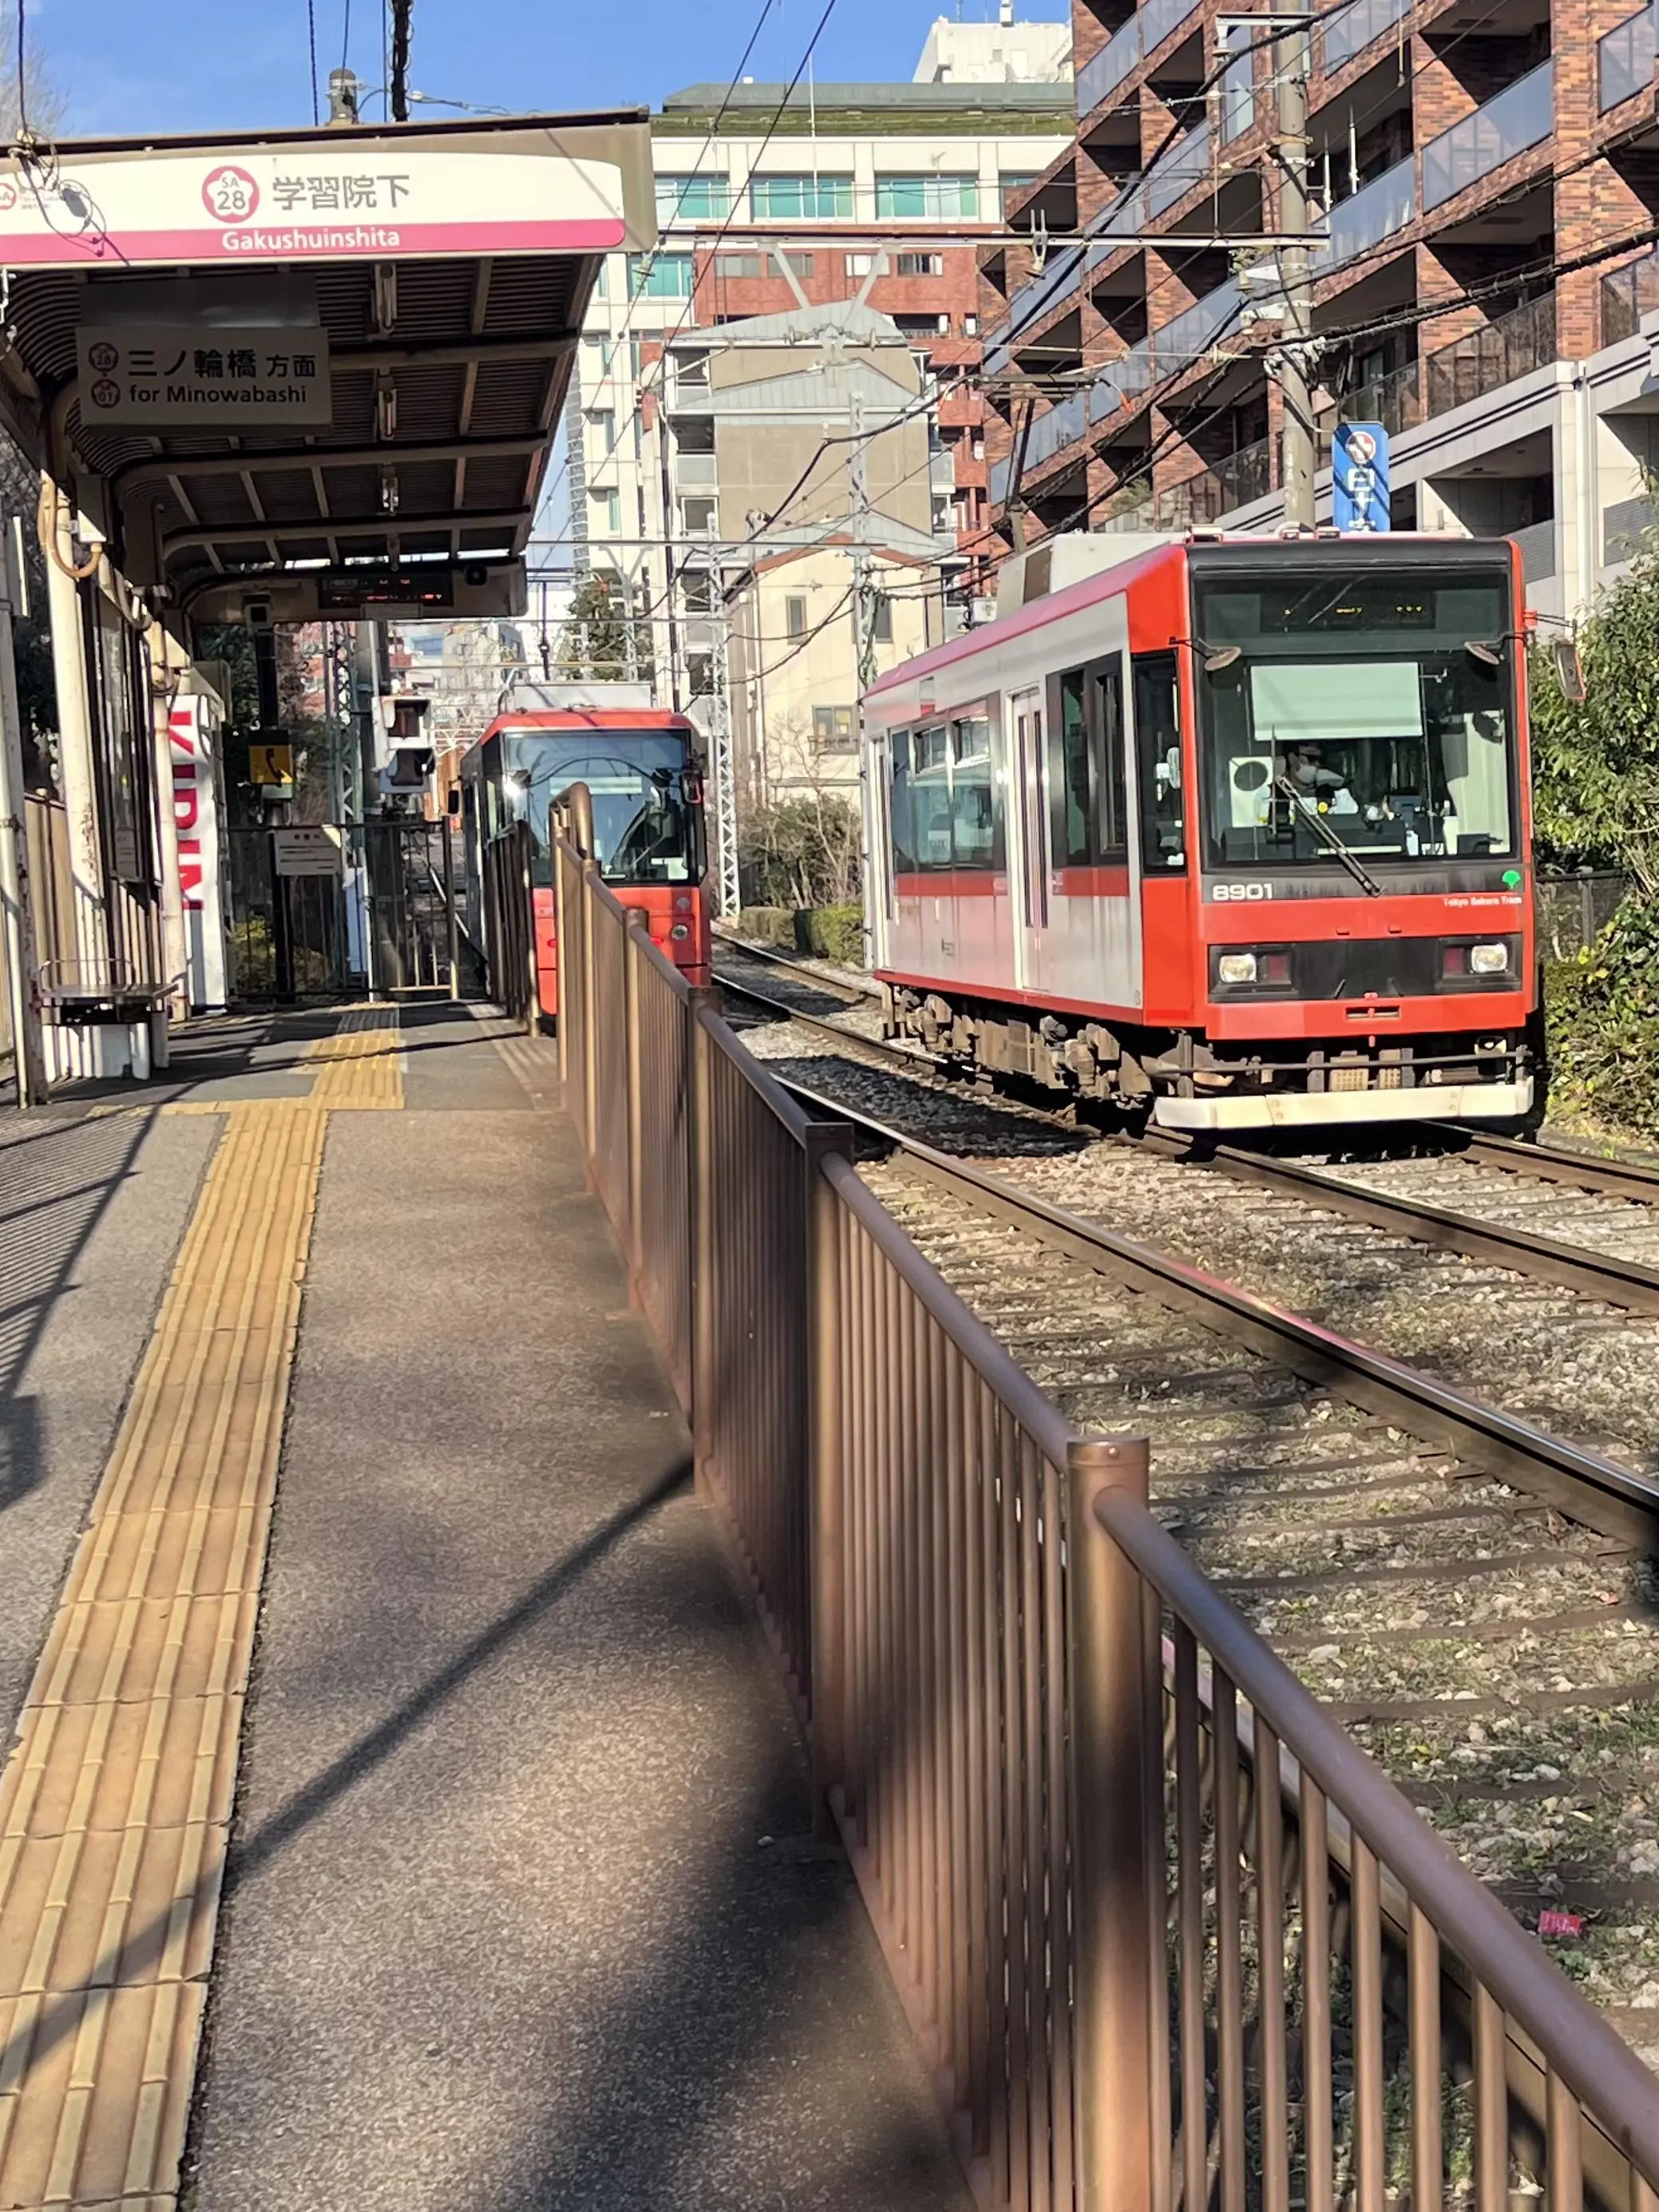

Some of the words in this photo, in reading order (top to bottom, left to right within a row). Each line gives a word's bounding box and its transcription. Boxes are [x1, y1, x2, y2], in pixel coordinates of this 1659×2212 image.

[221, 176, 240, 189] SA
[272, 174, 410, 211] 学習院下
[216, 190, 247, 210] 28
[221, 227, 401, 251] Gakushuinshita
[128, 348, 256, 378] 三ノ輪橋
[266, 354, 316, 378] 方面
[129, 384, 160, 403] for
[167, 385, 307, 403] Minowabashi
[1213, 883, 1273, 901] 8901
